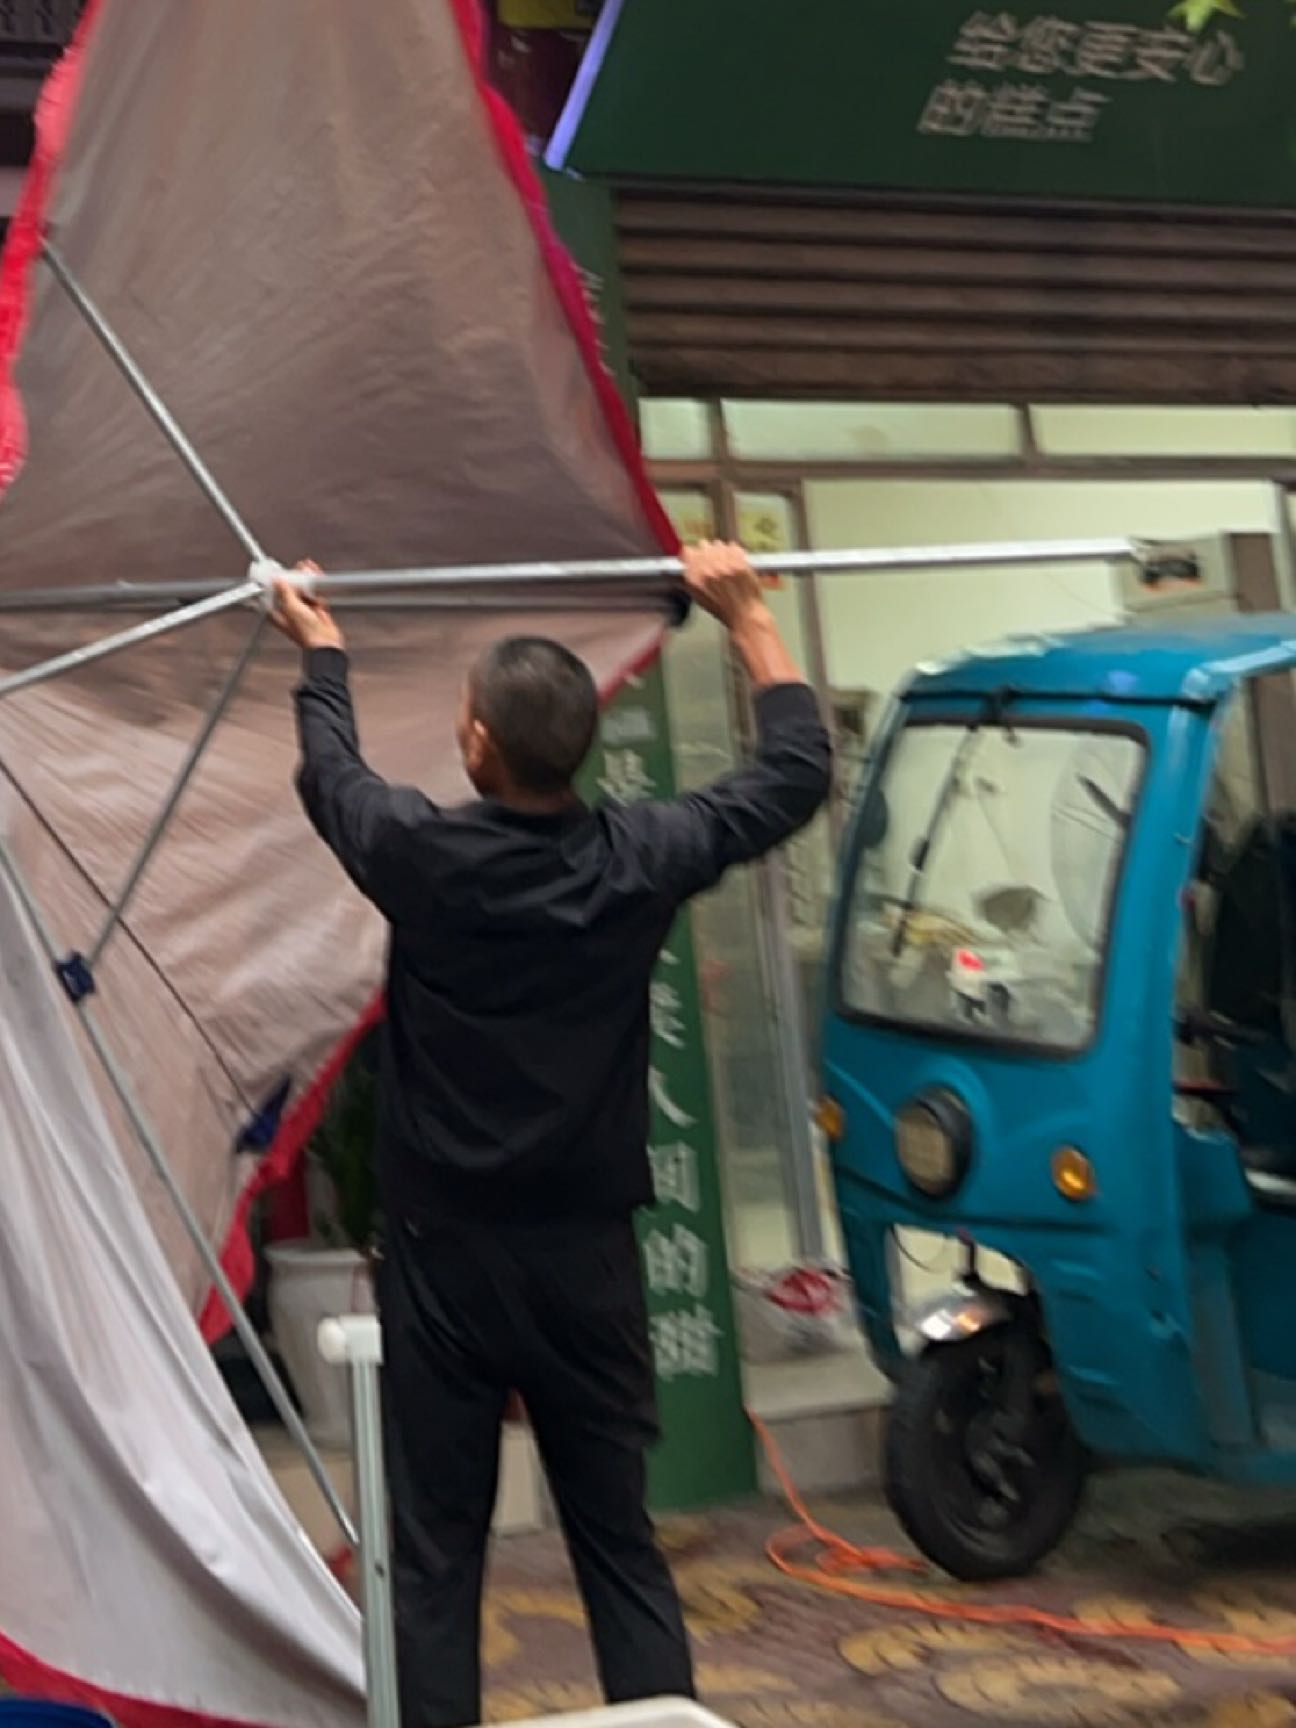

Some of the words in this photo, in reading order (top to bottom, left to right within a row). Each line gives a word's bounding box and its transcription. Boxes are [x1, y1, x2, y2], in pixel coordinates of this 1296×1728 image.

[945, 10, 1245, 87] 给您更安心
[916, 78, 1112, 142] 的糕点
